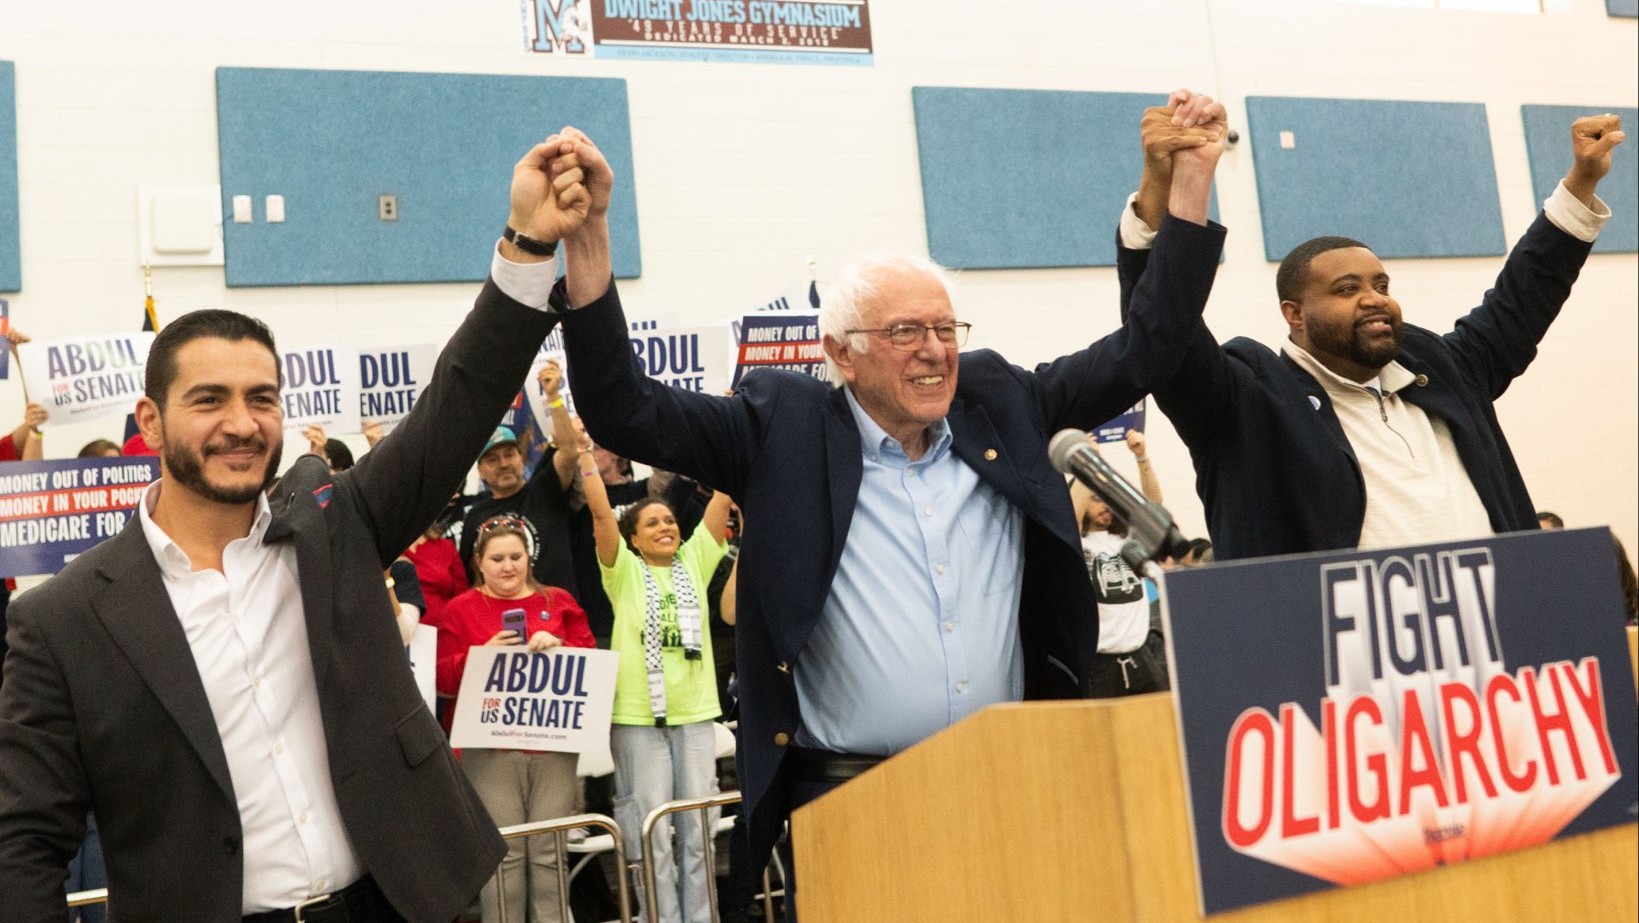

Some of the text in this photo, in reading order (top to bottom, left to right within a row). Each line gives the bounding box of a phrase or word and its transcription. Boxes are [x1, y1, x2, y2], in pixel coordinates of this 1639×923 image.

[604, 0, 862, 28] DWIGHT JONES GYMNASIUM
[666, 20, 722, 36] YEARS
[735, 23, 753, 37] OF
[747, 327, 784, 343] MONEY
[784, 326, 805, 341] OUT
[805, 325, 818, 341] OF
[47, 339, 143, 380] ABDUL
[744, 346, 782, 362] MONEY
[783, 345, 796, 360] IN
[281, 349, 342, 390] DUL
[52, 382, 70, 394] FOR
[54, 392, 73, 408] US
[280, 388, 342, 419] ENATE
[0, 464, 152, 494] MONEY OUT OF POLITICS
[0, 495, 50, 518] MONEY
[53, 493, 70, 512] IN
[73, 490, 109, 511] YOUR
[0, 511, 126, 548] MEDICARE FOR
[1320, 547, 1503, 688] FIGHT
[484, 652, 589, 697] ABDUL
[480, 696, 586, 730] US SENATE
[482, 697, 502, 710] FOR
[1224, 655, 1620, 849] OLIGARCHY
